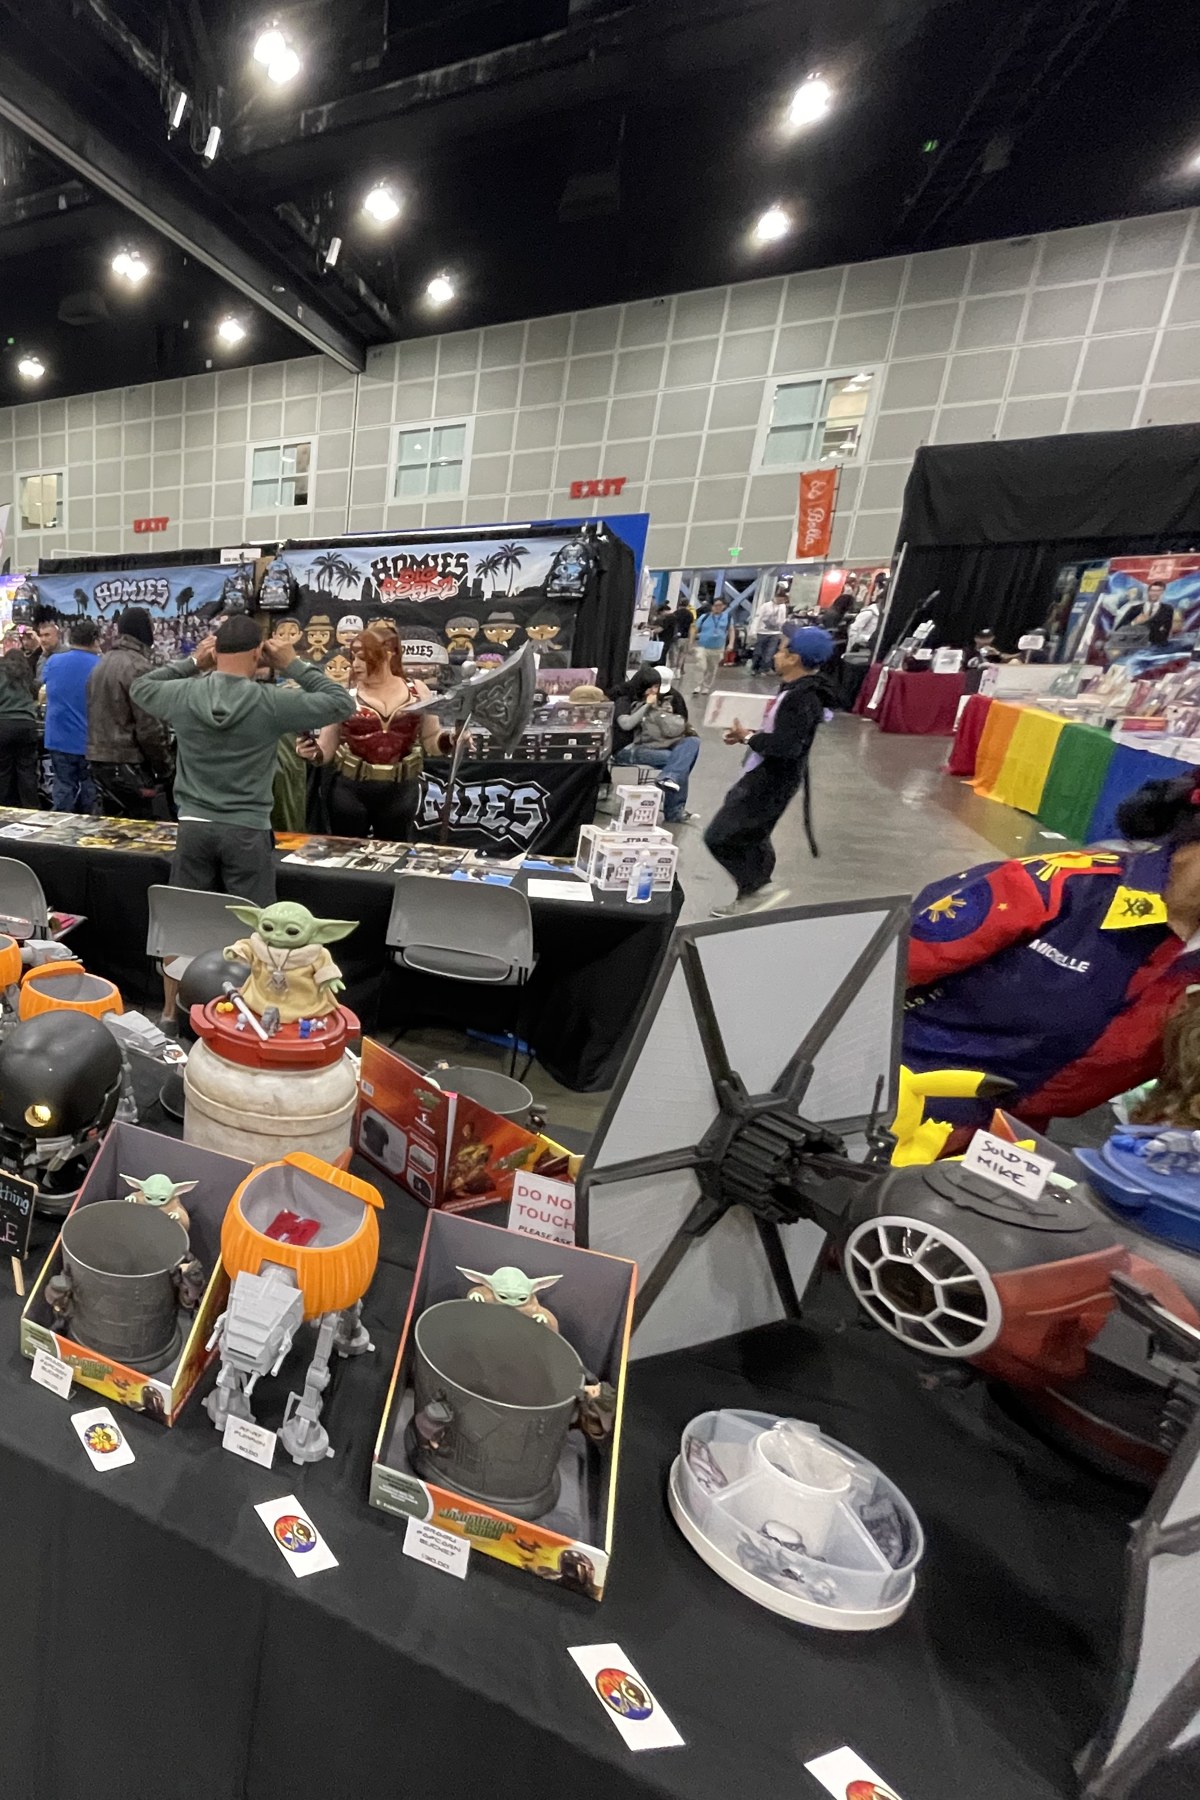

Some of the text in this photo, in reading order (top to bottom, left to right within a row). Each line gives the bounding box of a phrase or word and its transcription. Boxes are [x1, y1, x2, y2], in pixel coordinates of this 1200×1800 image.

[569, 477, 627, 499] EXIT
[133, 517, 169, 533] EXIT
[371, 552, 469, 588] HOMIES
[94, 578, 170, 608] HOMIES
[423, 781, 543, 839] MIES
[981, 1140, 1021, 1163] SOLD
[977, 1156, 1026, 1187] MIKE
[517, 1185, 574, 1210] DO NO
[517, 1204, 576, 1231] TOUCH
[518, 1224, 552, 1239] PLEASE
[416, 1530, 461, 1552] POPCORN
